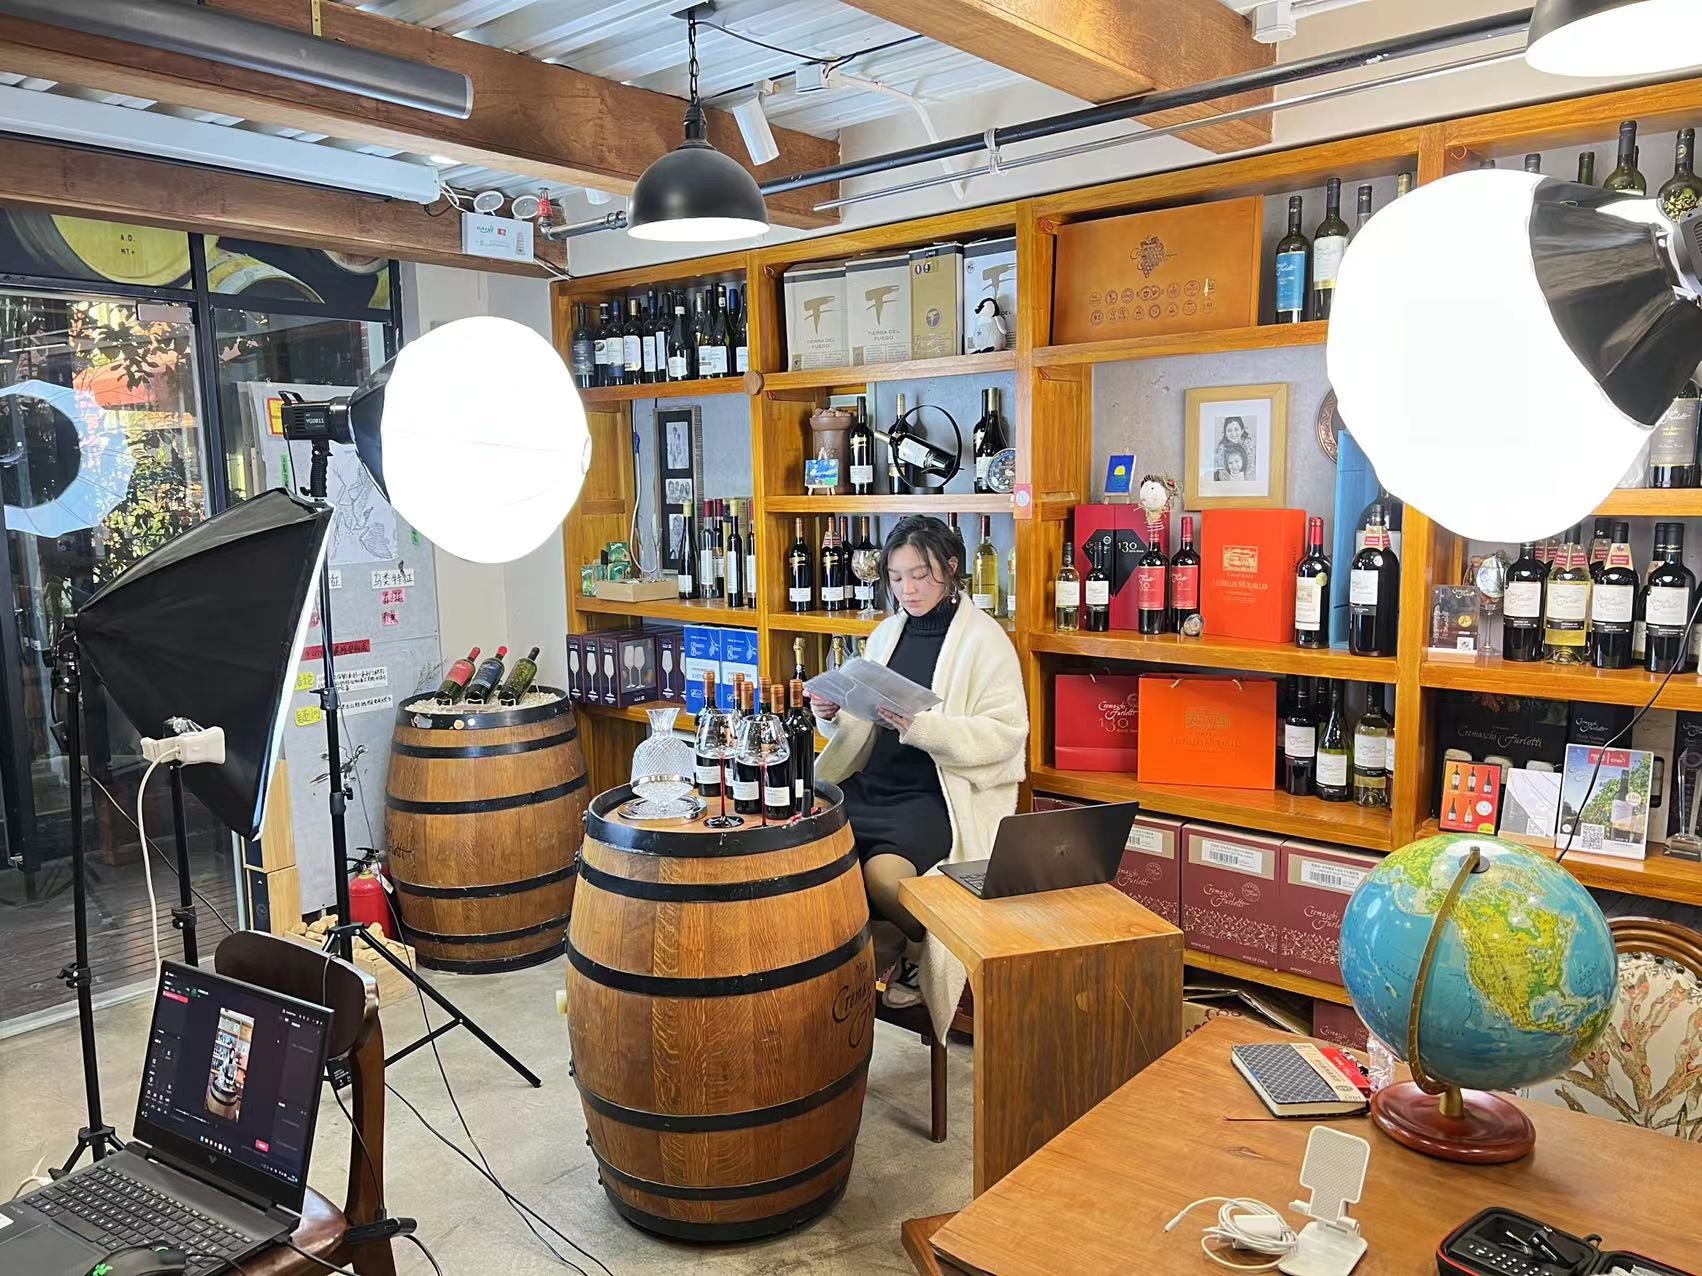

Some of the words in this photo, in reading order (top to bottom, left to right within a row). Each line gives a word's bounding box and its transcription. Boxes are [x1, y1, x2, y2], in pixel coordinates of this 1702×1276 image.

[1458, 726, 1497, 740] Cremaschi
[1498, 734, 1545, 748] Furlotti
[1203, 883, 1234, 898] Cremaschi
[1303, 905, 1338, 920] Cremaschi
